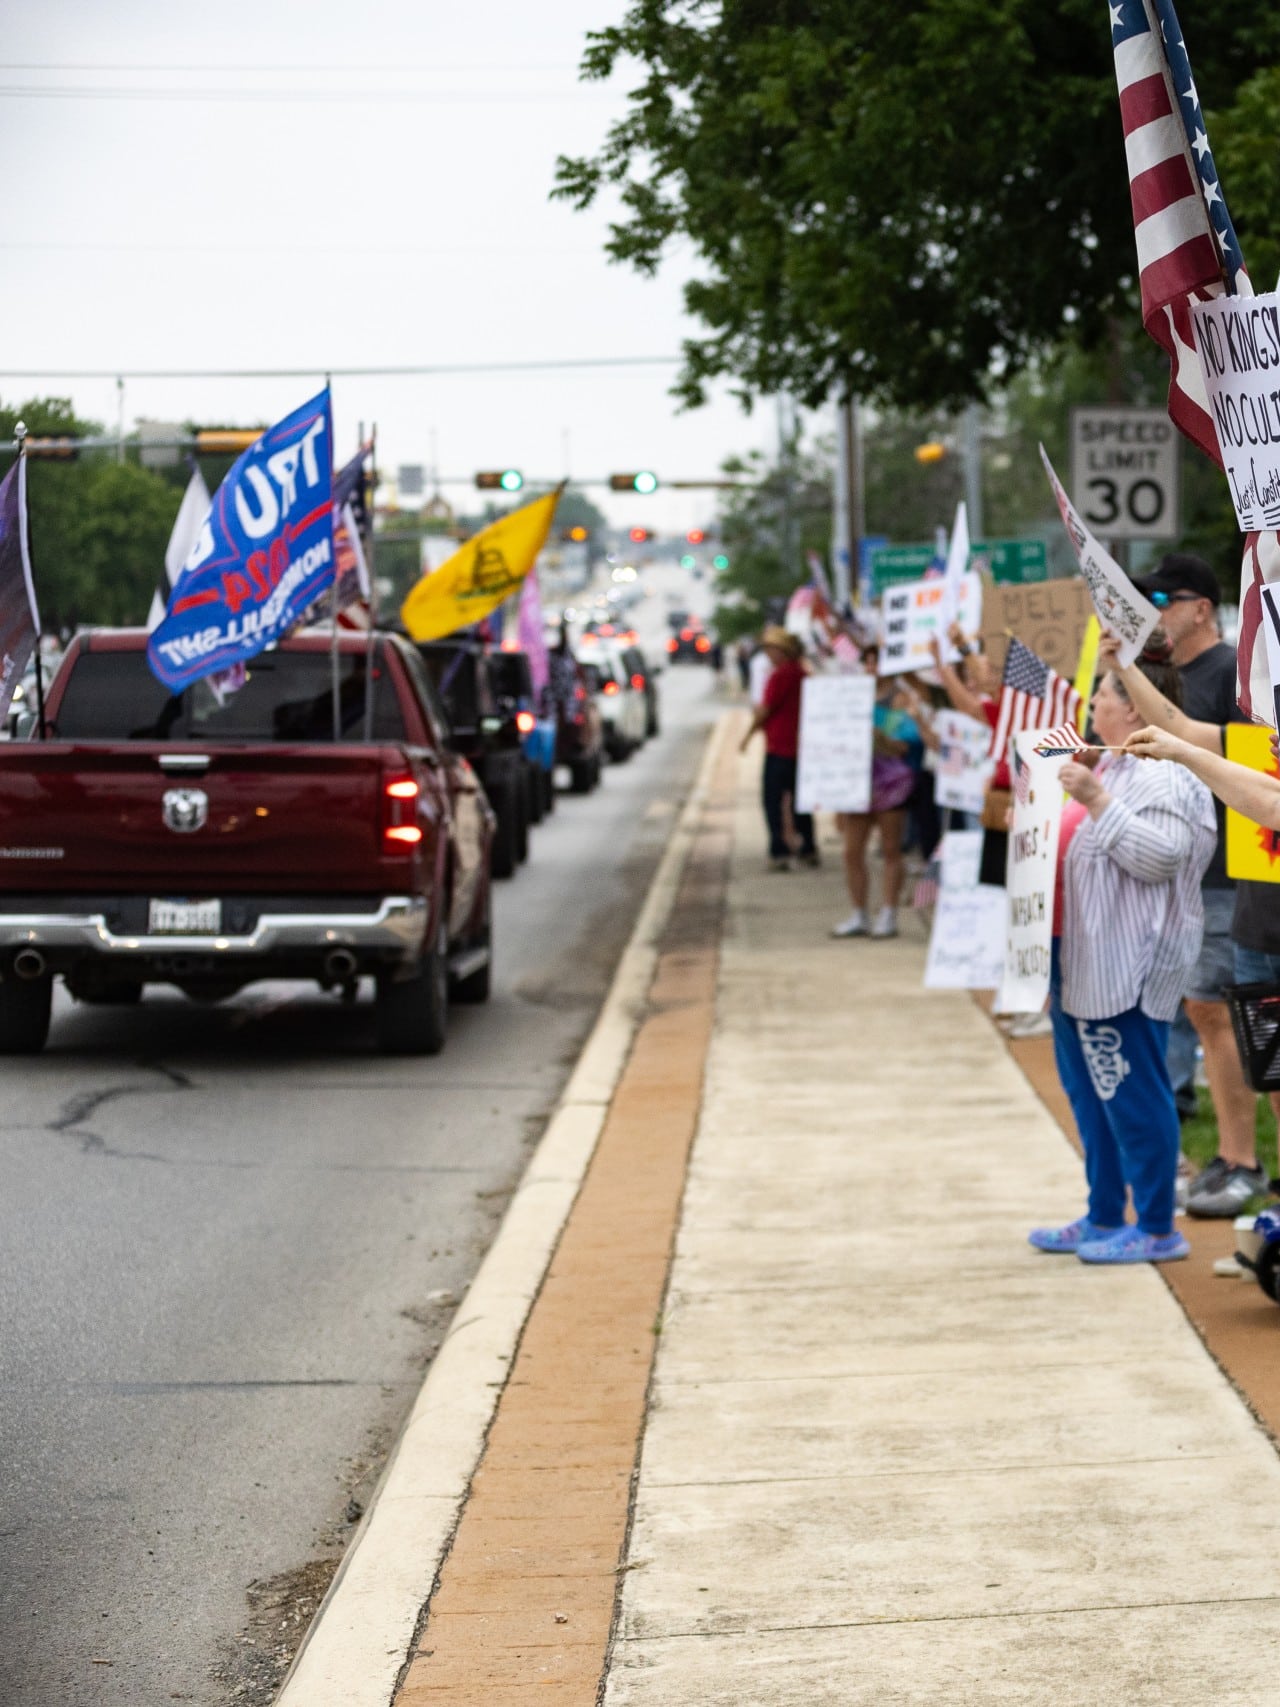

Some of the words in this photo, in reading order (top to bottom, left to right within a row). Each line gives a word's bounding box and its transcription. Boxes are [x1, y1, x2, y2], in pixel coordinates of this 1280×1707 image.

[1195, 312, 1225, 378] NO
[1082, 421, 1170, 444] SPEED
[1213, 392, 1243, 448] NO
[1089, 451, 1158, 471] LIMIT
[1085, 477, 1165, 525] 30
